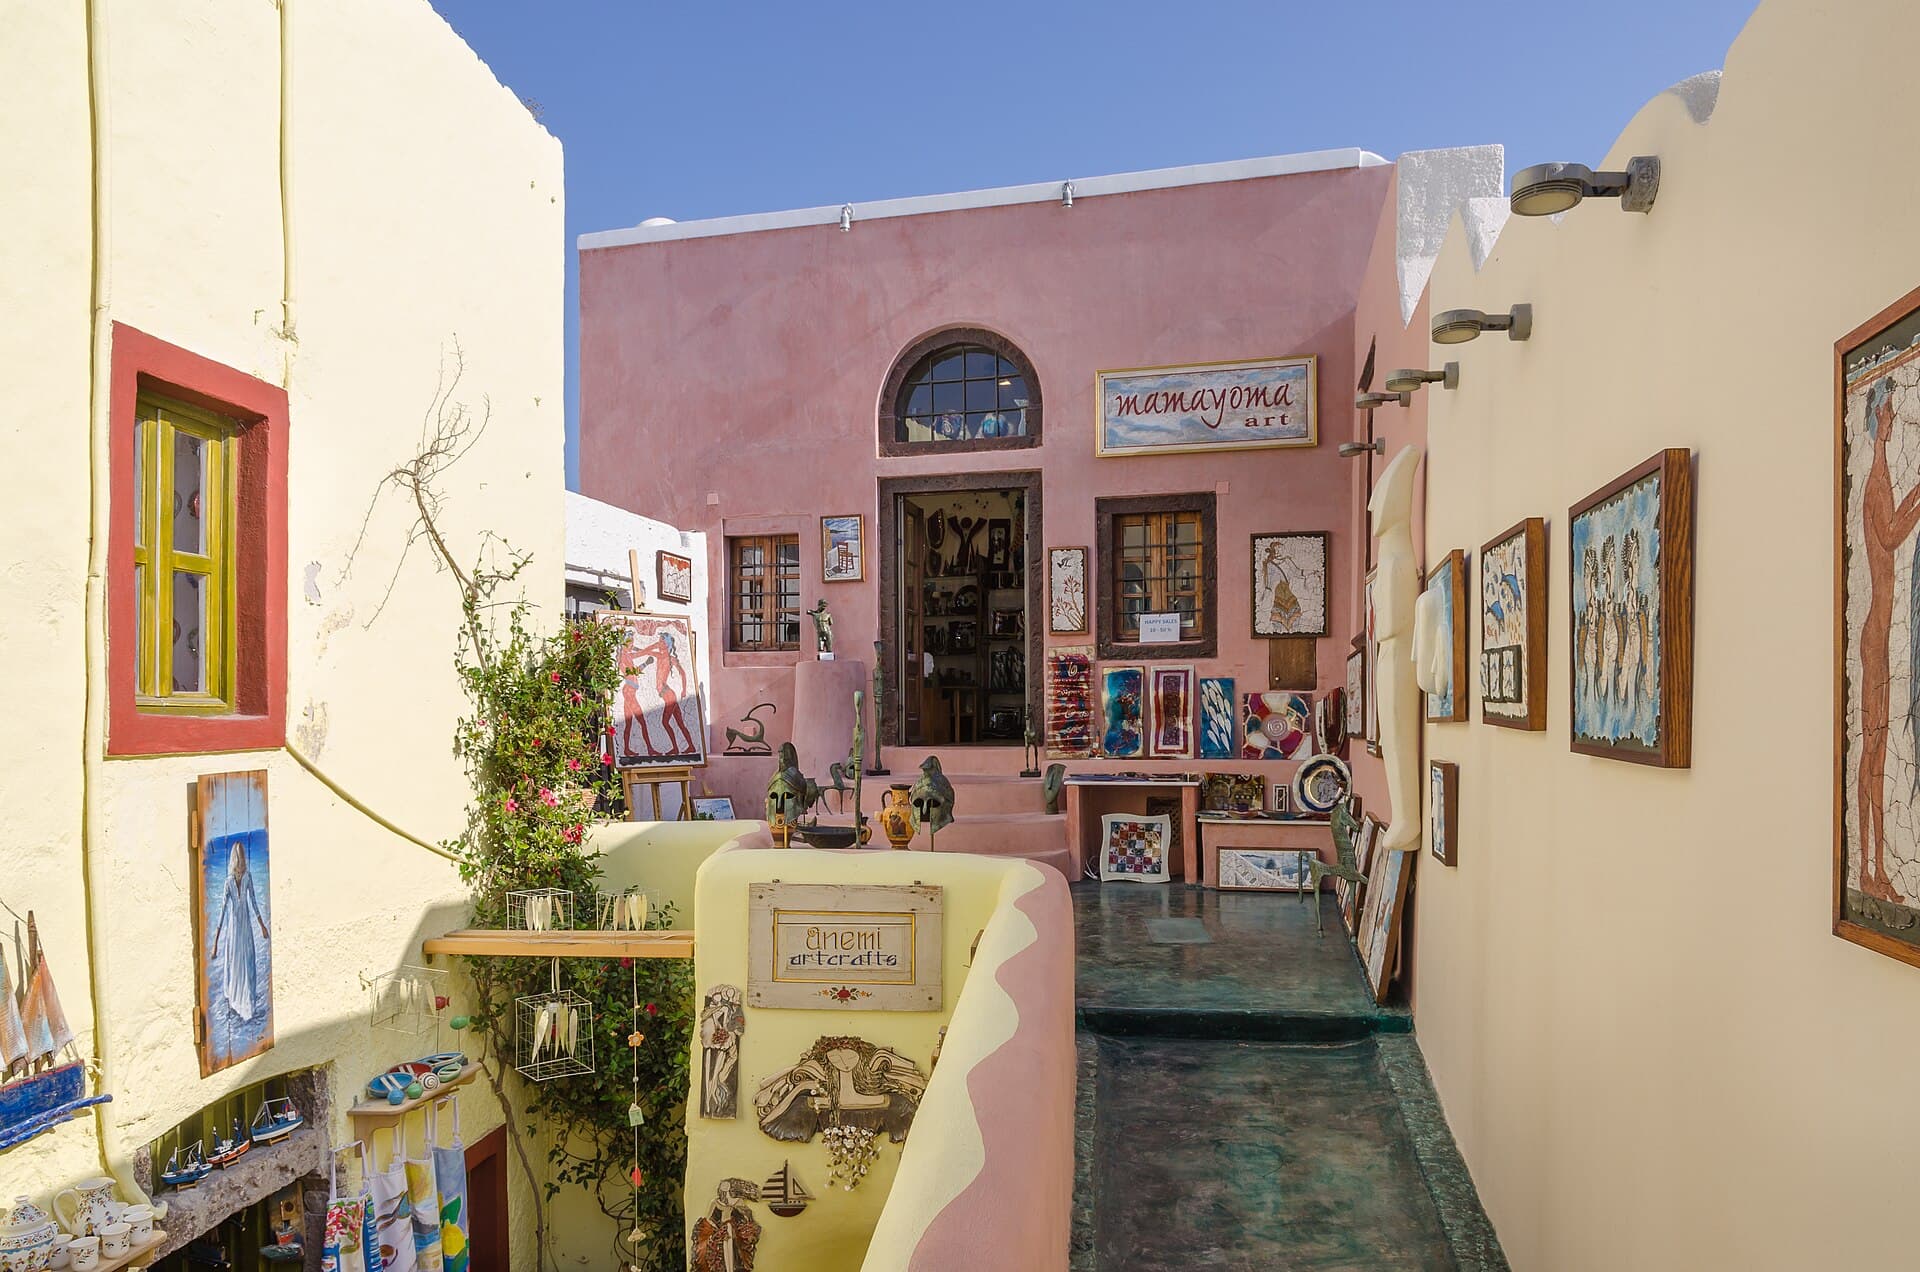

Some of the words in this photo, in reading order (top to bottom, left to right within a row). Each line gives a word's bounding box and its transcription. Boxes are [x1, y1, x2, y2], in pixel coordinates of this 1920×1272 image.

[1115, 383, 1294, 429] mamayoma
[1244, 413, 1290, 427] art
[805, 926, 882, 951] anemi
[789, 950, 898, 967] artcrafts
